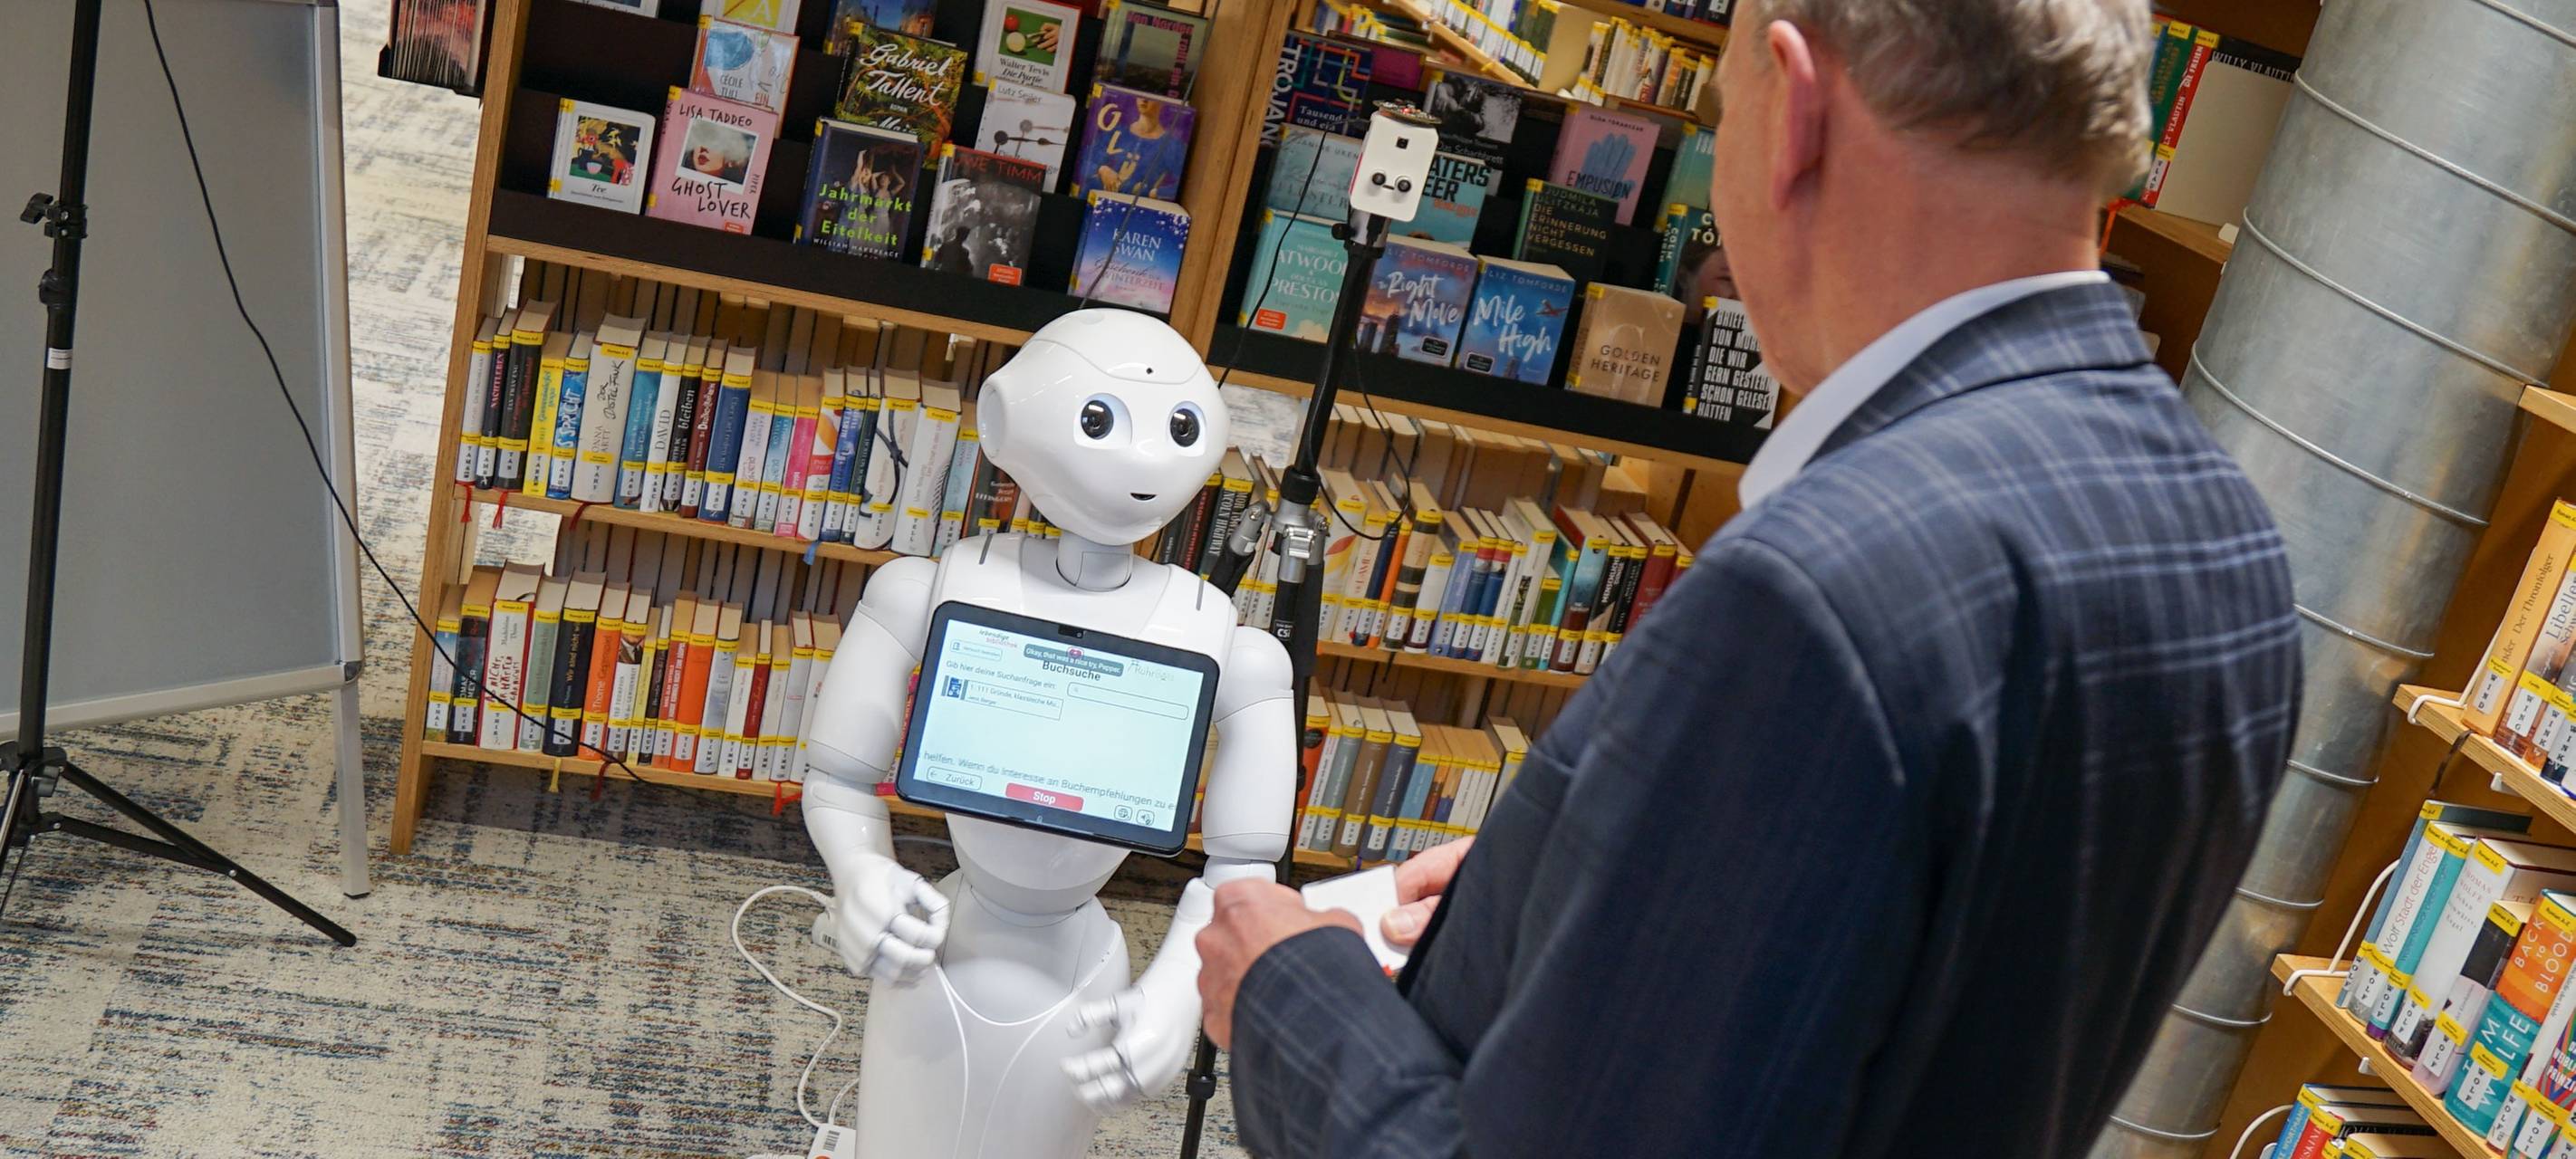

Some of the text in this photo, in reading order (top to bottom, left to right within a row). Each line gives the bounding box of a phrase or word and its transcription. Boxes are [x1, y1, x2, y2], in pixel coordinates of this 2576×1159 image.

[860, 43, 952, 76] Gabriel
[2212, 50, 2250, 69] WILLY
[866, 70, 942, 106] Tallent
[1260, 44, 1302, 147] TROJAN
[679, 103, 752, 127] LISA TADDEO
[954, 157, 1043, 181] UWE TIMM
[1428, 156, 1491, 187] ATERS
[672, 177, 727, 199] GHOST
[820, 184, 912, 213] Jahrmarkt
[1423, 179, 1459, 203] EER
[1546, 186, 1596, 206] JUDMILA
[1566, 170, 1632, 200] EMPUSION
[697, 196, 751, 219] LOVER
[848, 207, 878, 224] der
[1533, 204, 1553, 216] DIE
[821, 220, 899, 246] Eitelkeit
[1112, 228, 1161, 250] KAREN
[1530, 223, 1567, 239] NICHT
[1531, 211, 1608, 240] ERINNERUNG
[812, 238, 848, 249] WILLIAM
[1528, 233, 1595, 257] VERGESSEN
[1278, 249, 1348, 275] ATWOO
[1387, 272, 1444, 299] Right
[1512, 274, 1570, 293] TOMFORDE
[1408, 299, 1459, 330] Move
[1474, 293, 1524, 327] Mile
[1499, 323, 1552, 362] High
[1714, 327, 1734, 347] VON
[1600, 344, 1660, 365] GOLDEN
[1708, 345, 1747, 369] DIE WIR
[491, 353, 505, 407] NACHTLEBEN
[1590, 358, 1660, 383] HERITAGE
[1704, 364, 1729, 386] GERN
[1700, 382, 1733, 404] SCHON
[558, 388, 581, 437] SPRICHT
[678, 389, 695, 429] bleiben
[591, 425, 603, 454] ONNA
[601, 429, 610, 454] ARTT
[655, 409, 670, 450] DAVID
[1236, 492, 1247, 509] MOR
[1208, 490, 1234, 555] NCOLN HIGHWAY
[1183, 533, 1197, 570] ENTLEMAN
[2501, 553, 2554, 665] nder Der Thronfolger
[946, 660, 958, 670] Gib
[960, 662, 975, 673] hier
[976, 666, 995, 677] deine
[996, 670, 1041, 689] Suchanfrage
[1043, 660, 1101, 682] Buchsuche
[2478, 674, 2497, 709] WIND
[2514, 694, 2533, 730] WING
[2539, 710, 2560, 747] WINK
[2556, 724, 2576, 761] WINK
[924, 751, 1166, 809] helfen. Wenn du Interesse an Buchempfehlungen zu
[946, 771, 975, 787] Zurück
[1033, 790, 1056, 806] Stop
[2381, 844, 2438, 955] Wolf Stadt der Enge
[2514, 917, 2544, 968] BACK
[2534, 931, 2574, 994] BLOOD
[2361, 969, 2380, 1001] WOLF
[2377, 984, 2394, 1018] WOLF
[2398, 1001, 2417, 1033] WOLF
[2431, 1035, 2450, 1068] WOLF
[2462, 1017, 2501, 1072] TM
[2479, 1013, 2531, 1106] WLFE
[2552, 1047, 2576, 1074] WEIBLI
[2465, 1067, 2485, 1101] WOLF
[2546, 1065, 2576, 1094] PRINZI
